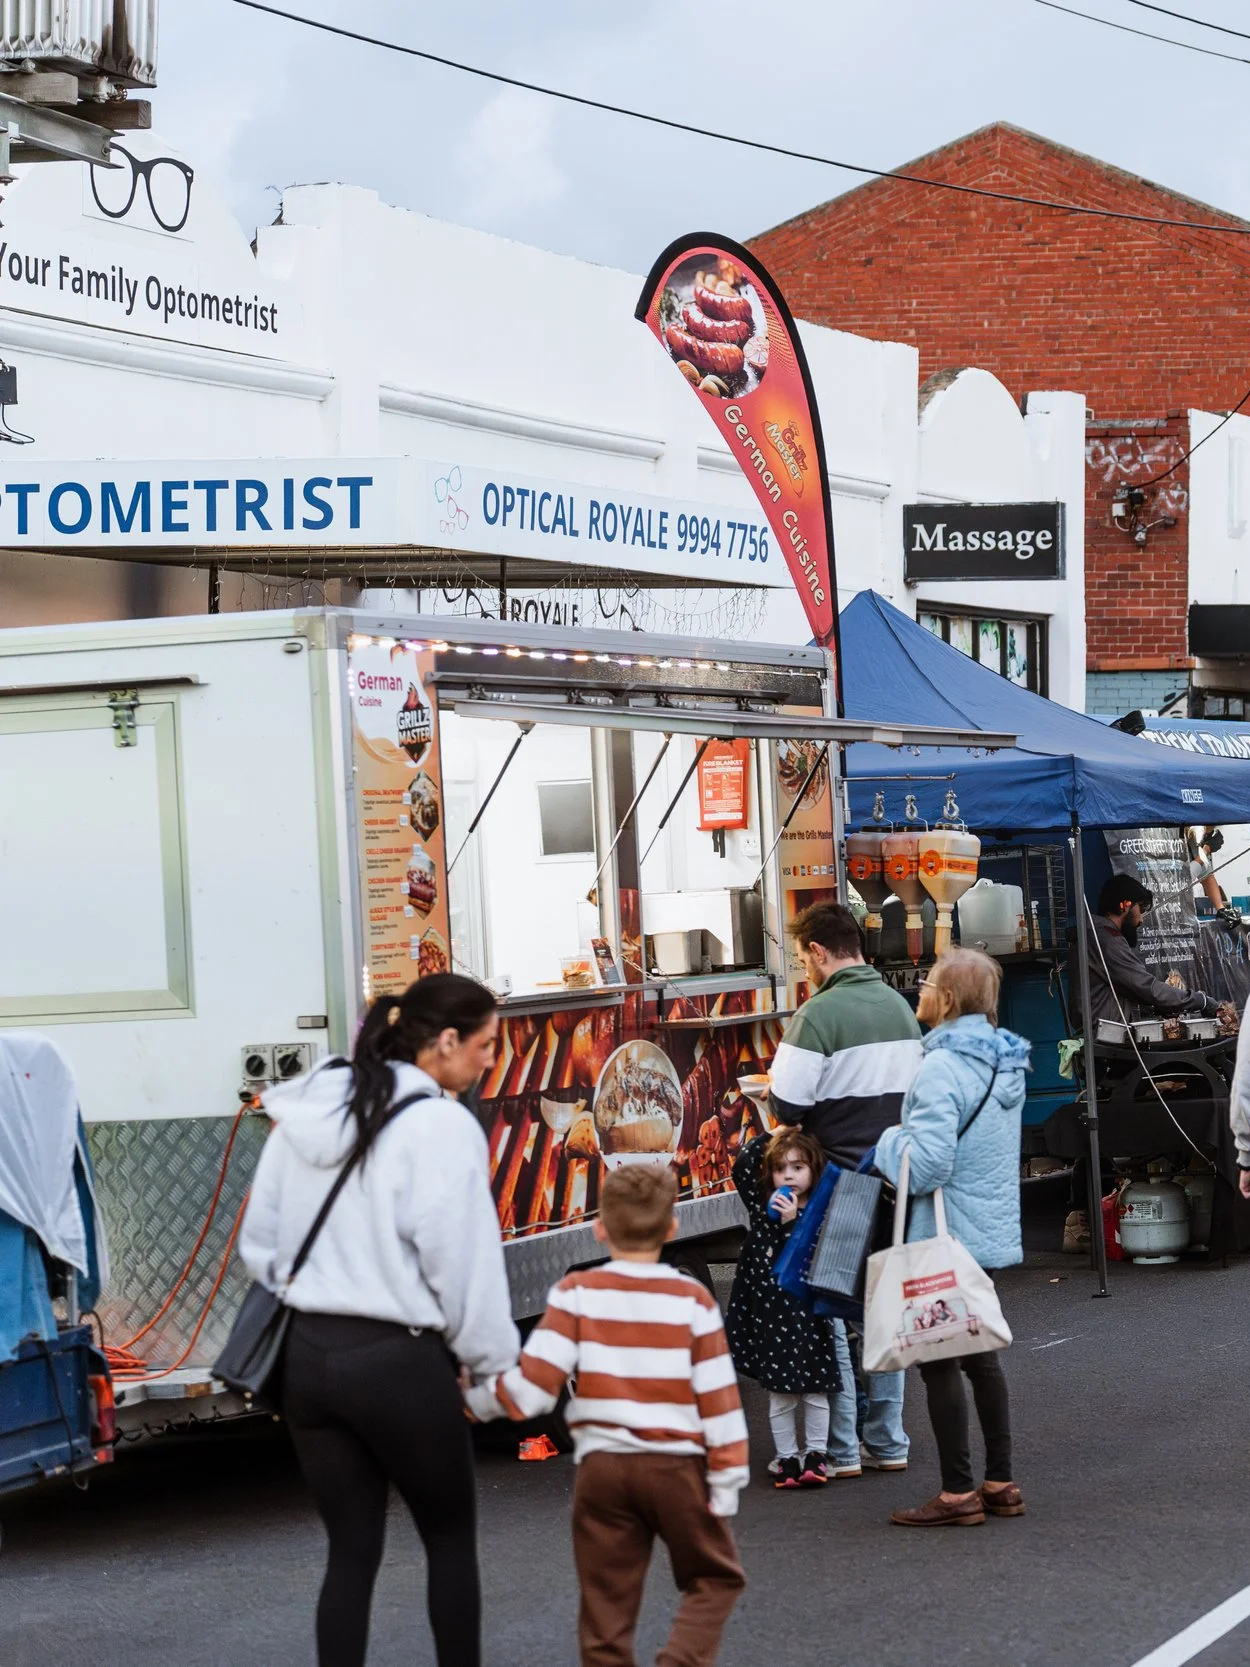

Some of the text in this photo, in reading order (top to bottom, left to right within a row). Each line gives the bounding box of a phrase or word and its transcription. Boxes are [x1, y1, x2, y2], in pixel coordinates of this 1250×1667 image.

[59, 255, 138, 315] Family
[146, 276, 278, 333] Optometrist
[766, 423, 802, 480] Master
[0, 477, 373, 535] TOMETRIST
[483, 482, 769, 563] OPTICAL ROYALE 9994 7756
[724, 405, 825, 606] German Cuisine
[911, 523, 1053, 560] Massage
[358, 671, 403, 691] German
[359, 696, 383, 707] Cuisine
[398, 708, 430, 730] GRILLZ
[399, 727, 431, 744] MASTER
